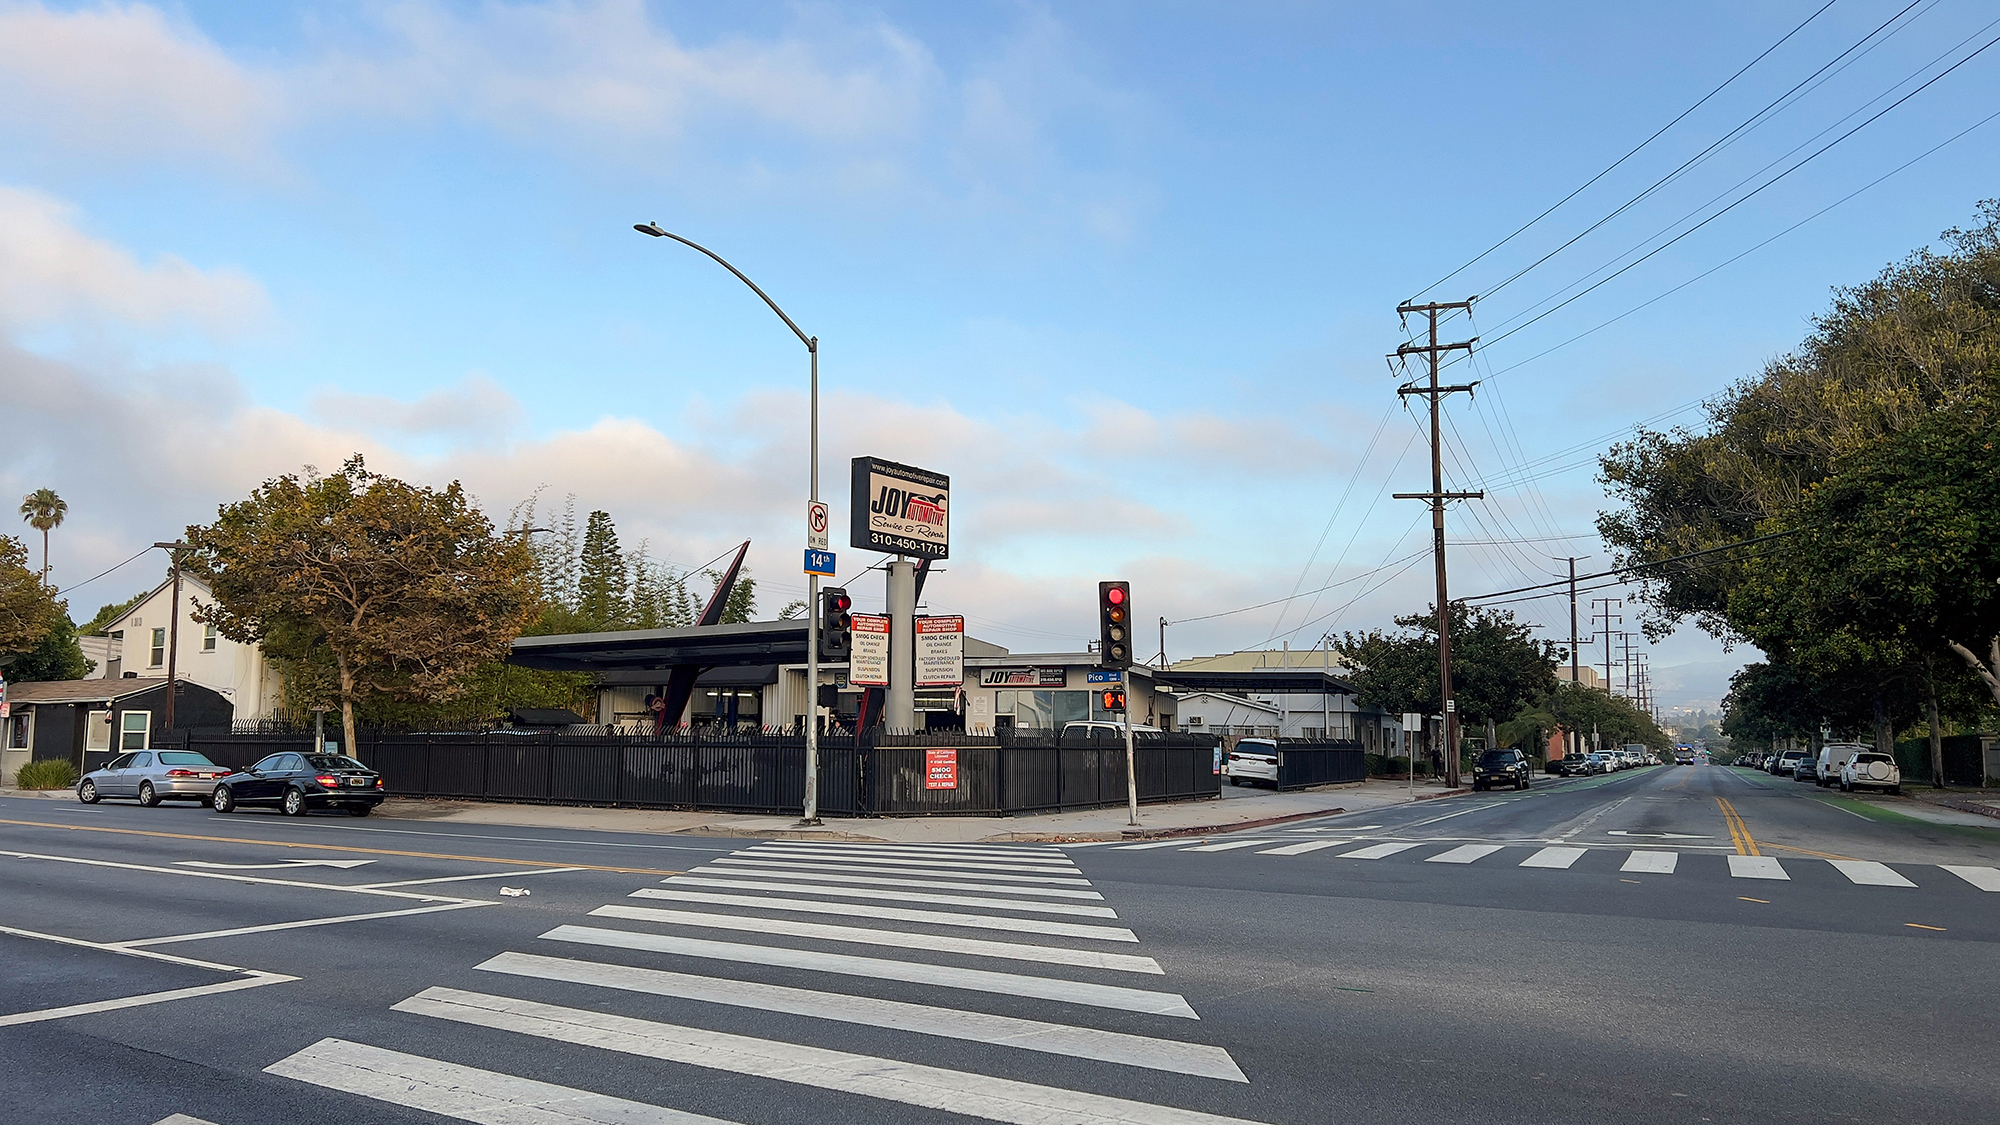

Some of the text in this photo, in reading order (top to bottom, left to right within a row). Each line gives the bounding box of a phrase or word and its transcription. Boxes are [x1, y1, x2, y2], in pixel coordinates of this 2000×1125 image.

[871, 463, 948, 487] www.joyautomotiverepair.com
[870, 485, 945, 526] JOY AUTOMOTIVE
[872, 516, 902, 530] Service
[915, 525, 945, 538] Repair
[818, 537, 827, 545] RED
[871, 533, 946, 555] 310-450-1712
[811, 553, 831, 568] 14th
[984, 671, 1035, 684] JOY AUTOMOTIVE
[1088, 673, 1104, 682] Pico
[1117, 694, 1126, 707] 4
